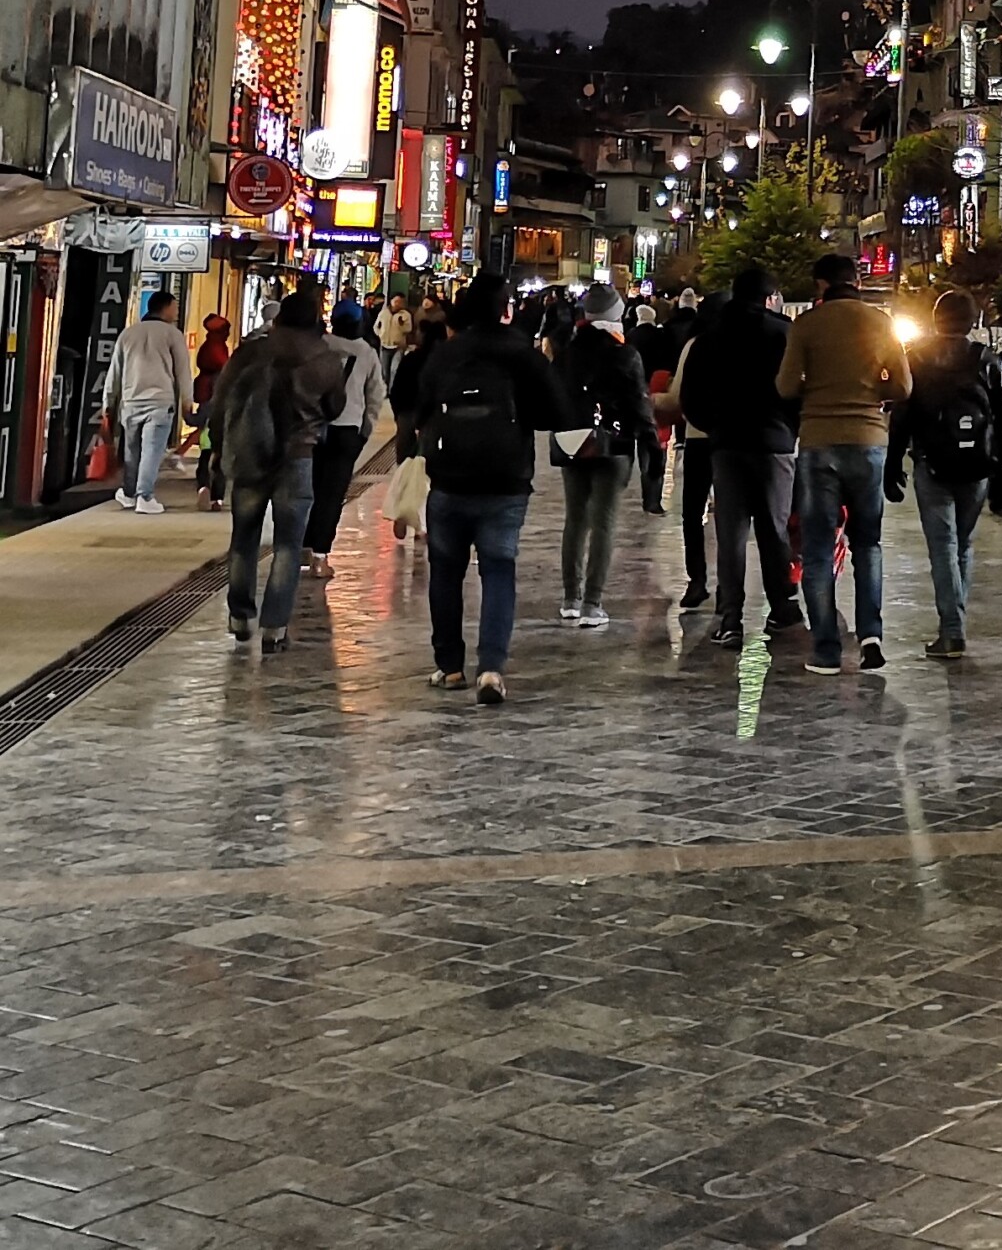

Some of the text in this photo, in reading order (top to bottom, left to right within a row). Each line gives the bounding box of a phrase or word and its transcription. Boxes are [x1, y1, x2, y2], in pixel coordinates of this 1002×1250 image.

[92, 91, 164, 162] HARROD'S
[376, 46, 395, 132] momo.co
[460, 40, 475, 150] RESIDENY
[427, 160, 440, 212] KARMA
